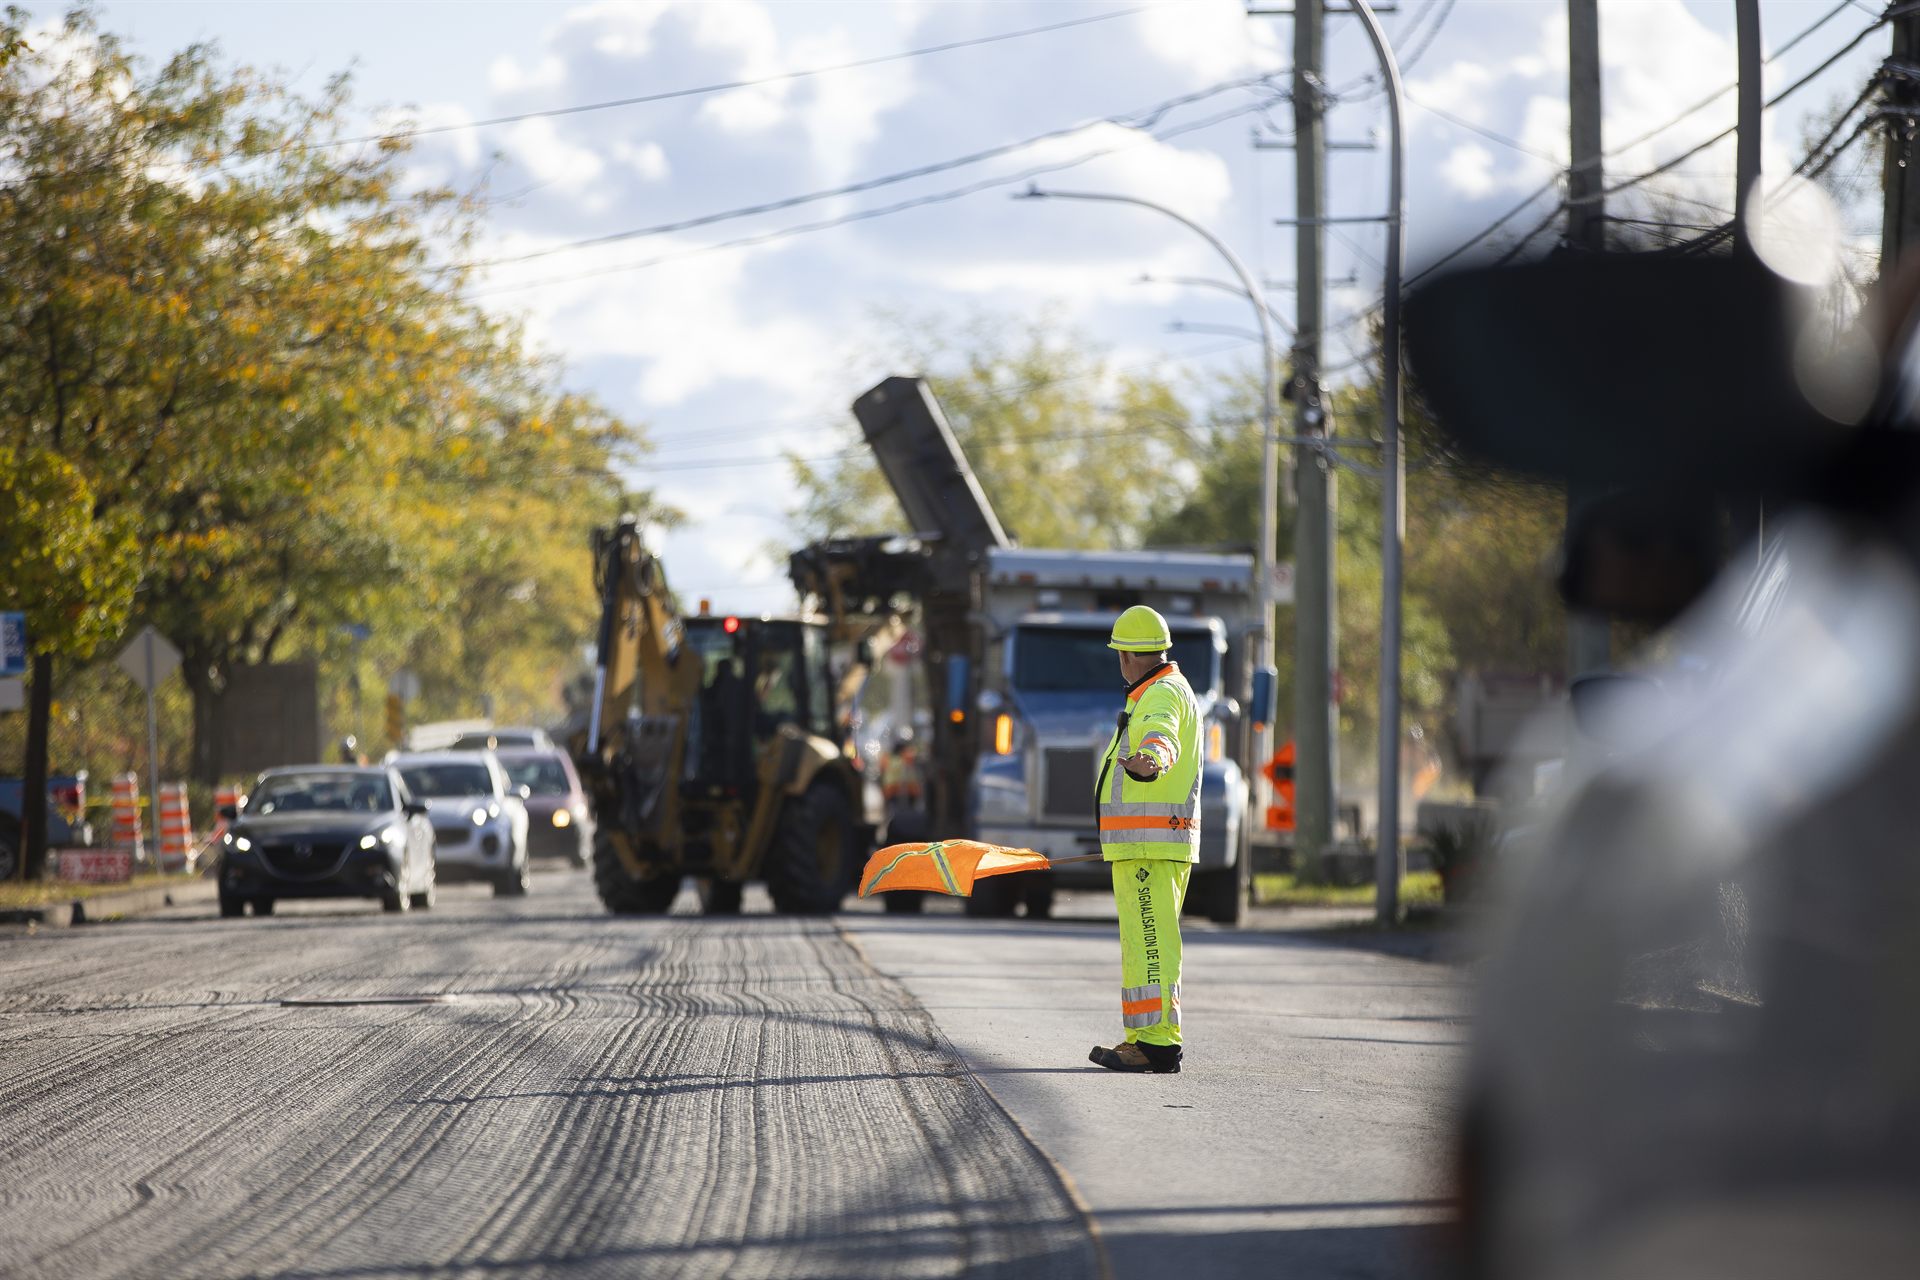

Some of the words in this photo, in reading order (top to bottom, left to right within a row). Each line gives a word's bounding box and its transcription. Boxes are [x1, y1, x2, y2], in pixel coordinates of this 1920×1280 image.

[1138, 887, 1157, 947] SIGNALISATION
[1146, 949, 1159, 960] DE
[1147, 962, 1160, 984] VILLE
